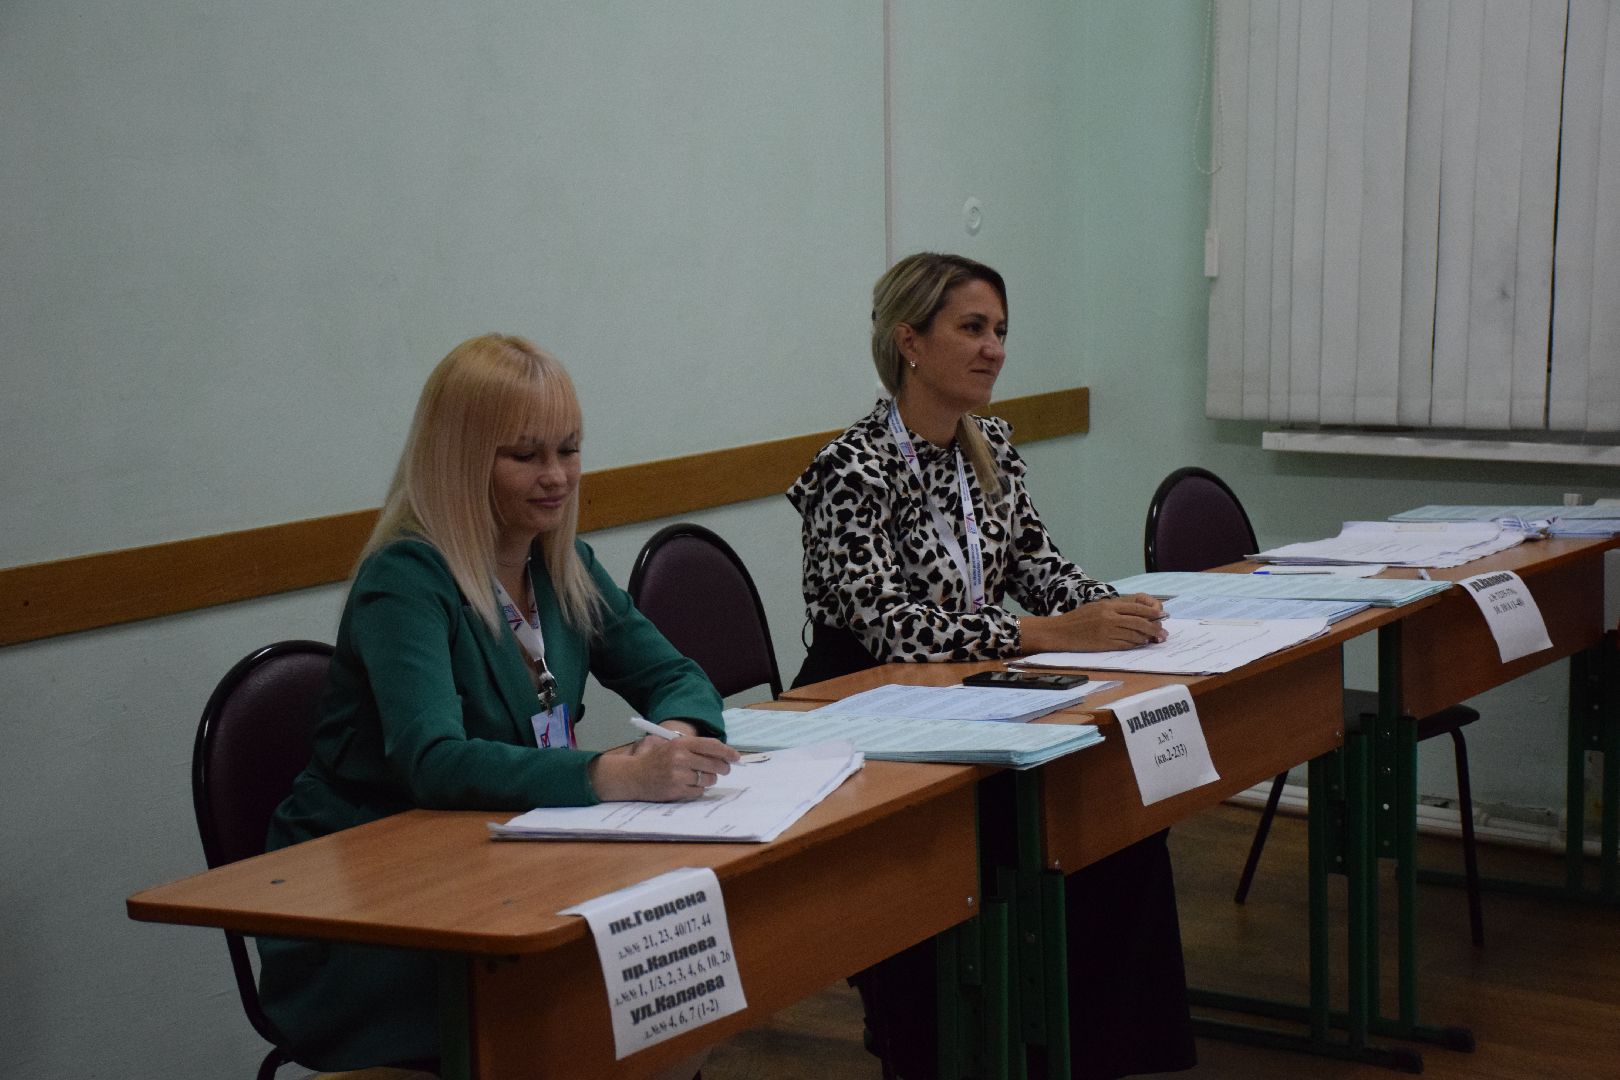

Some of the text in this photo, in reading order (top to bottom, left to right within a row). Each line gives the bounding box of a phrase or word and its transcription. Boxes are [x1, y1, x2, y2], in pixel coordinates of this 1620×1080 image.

[1126, 700, 1190, 733] ул.Каляева
[608, 890, 707, 935] пк.Герцена
[642, 934, 658, 949] 21,
[658, 928, 673, 944] 23,
[674, 918, 701, 937] 40/17,
[701, 912, 711, 927] 44
[622, 936, 717, 982] пр.Каляева
[639, 983, 648, 998] 1,
[649, 976, 666, 992] 1/3,
[667, 971, 676, 984] 2,
[677, 968, 686, 981] 3,
[688, 963, 697, 976] 4,
[697, 961, 706, 974] 6,
[707, 954, 720, 969] 10,
[720, 949, 731, 963] 26
[630, 975, 725, 1026] ул.Каляева
[668, 1015, 677, 1028] 4,
[679, 1011, 688, 1025] 6,
